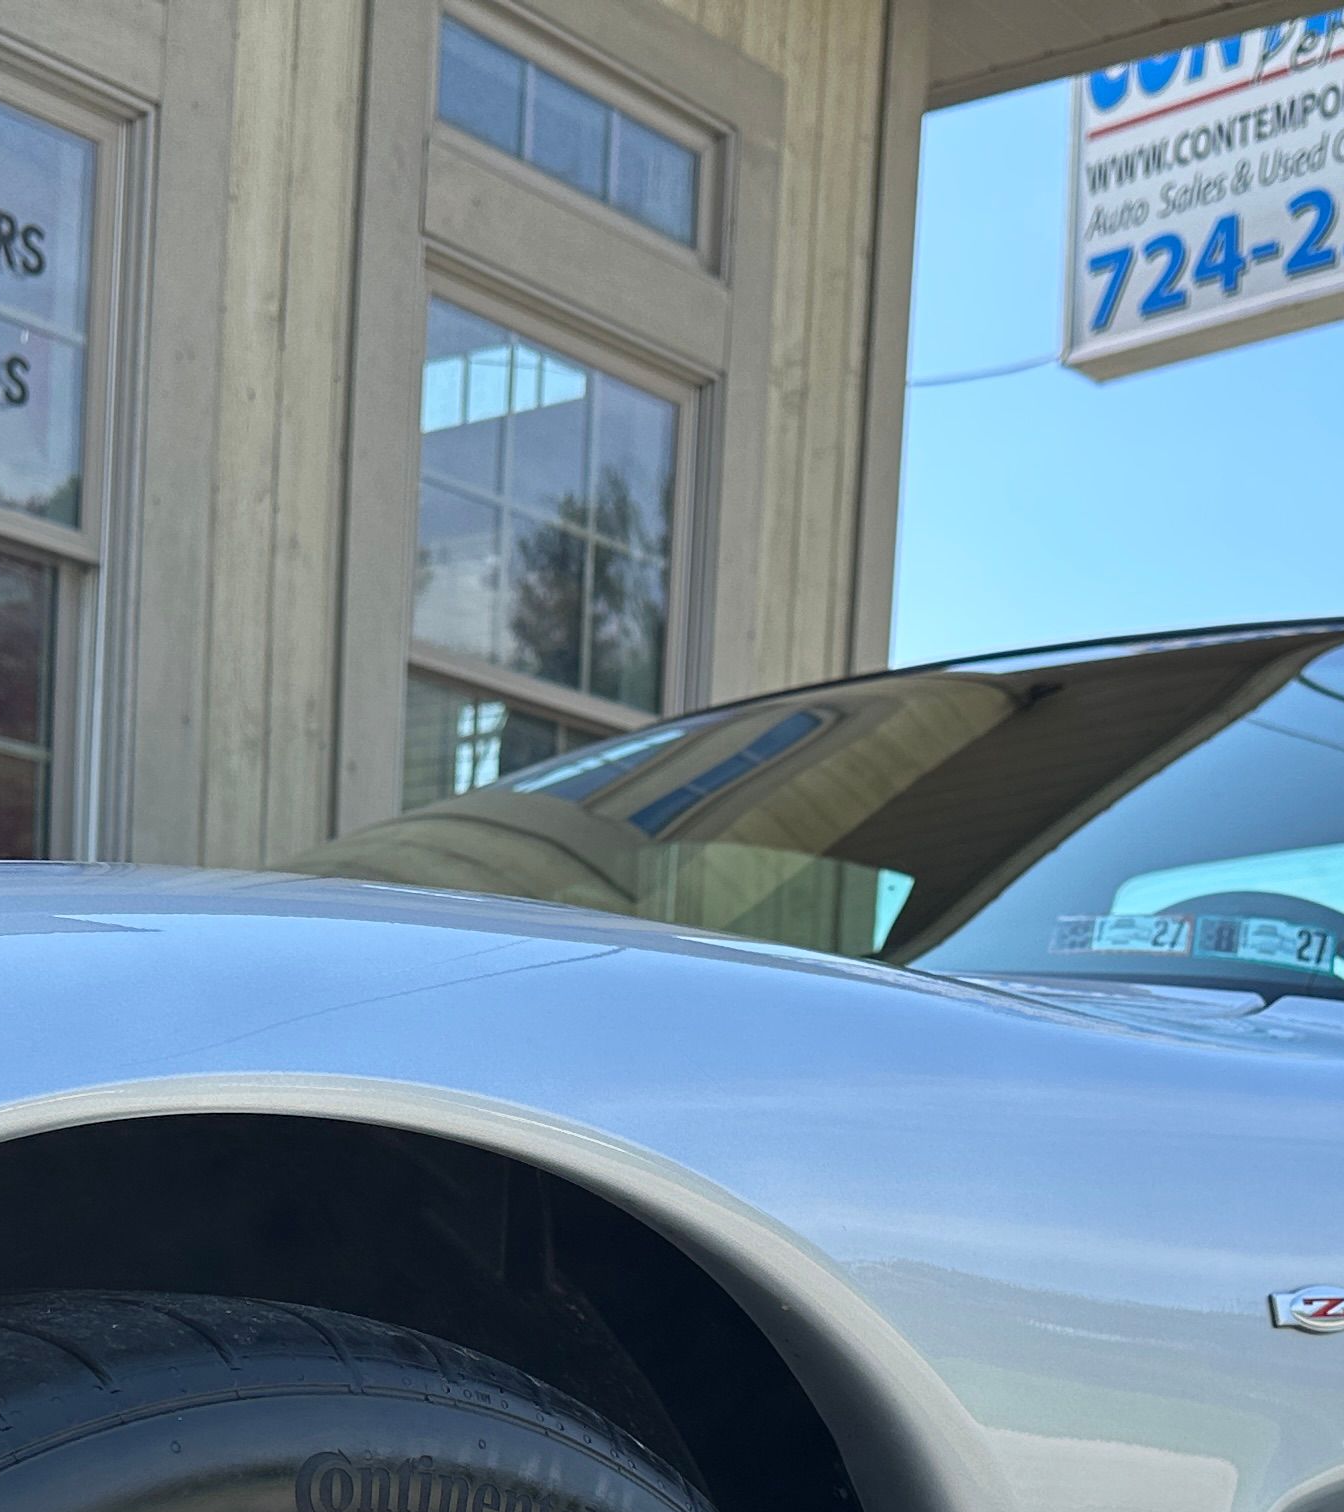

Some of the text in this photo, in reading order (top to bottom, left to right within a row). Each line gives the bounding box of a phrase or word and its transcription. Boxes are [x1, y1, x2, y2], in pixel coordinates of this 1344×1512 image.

[1085, 197, 1149, 241] Auto
[1157, 172, 1228, 219] Sales
[1230, 157, 1255, 196] &
[1258, 132, 1329, 187] Used
[1297, 928, 1328, 965] 27
